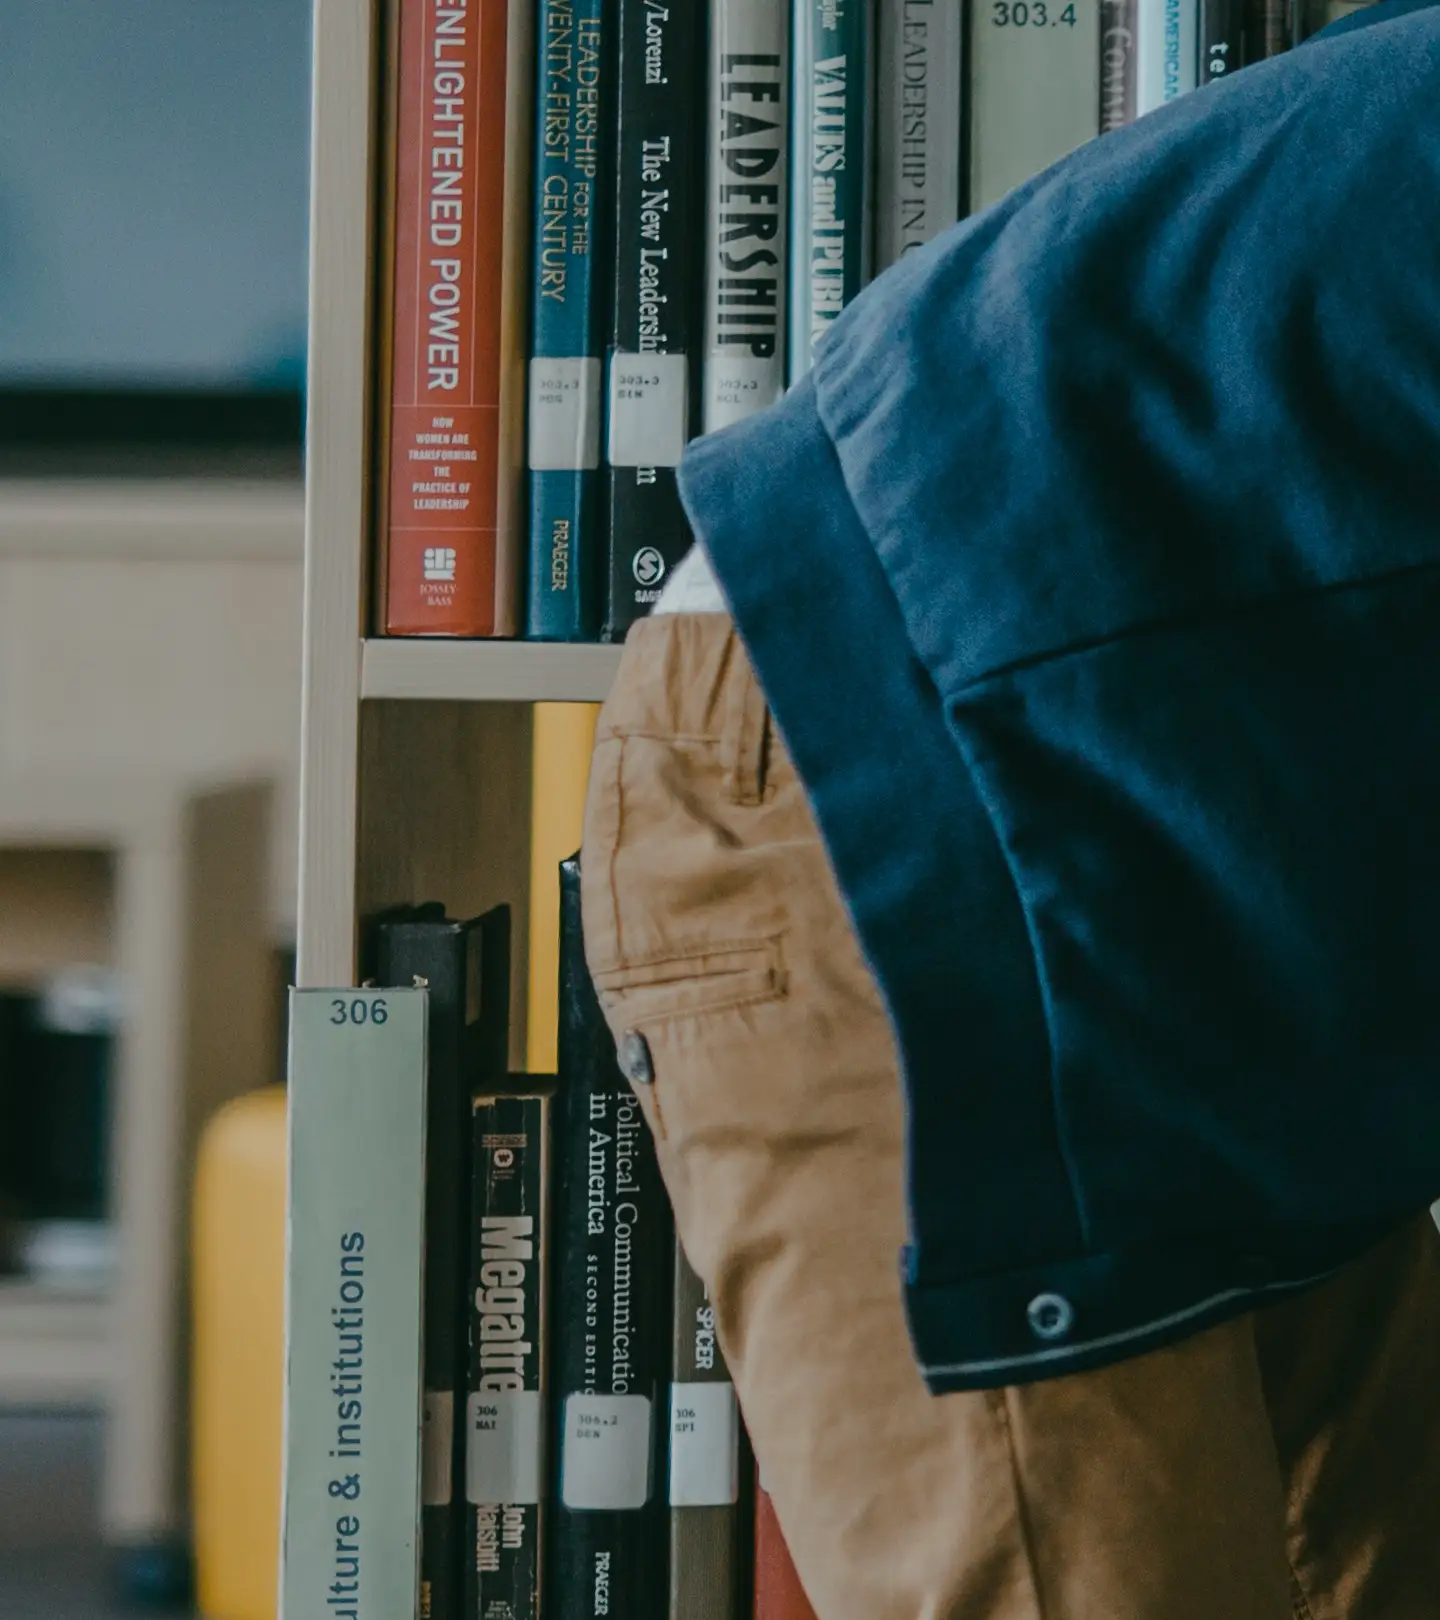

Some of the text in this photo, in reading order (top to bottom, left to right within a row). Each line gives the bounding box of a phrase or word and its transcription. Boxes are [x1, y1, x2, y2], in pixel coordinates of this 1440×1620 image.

[992, 2, 1079, 30] 303.4
[571, 18, 602, 256] LEADERSHIP FOR THE
[811, 54, 847, 231] VALUES and
[902, 0, 935, 231] LEADERSHIP IN
[427, 0, 469, 391] ENLIGHTENED POWER
[640, 136, 670, 241] The New
[717, 53, 781, 360] LEADERSHIP
[541, 174, 569, 303] CENTURY
[619, 375, 661, 388] 303.3
[415, 433, 470, 446] WOMEN ARE
[432, 416, 454, 429] HOW
[408, 450, 478, 462] TRANSFORMING
[412, 482, 472, 494] PRACTICE OF
[433, 465, 451, 478] THE
[413, 498, 470, 511] LEADERSHIP
[552, 519, 569, 592] PRAEGER
[329, 998, 389, 1026] 306
[587, 1092, 613, 1235] in America
[615, 1091, 642, 1194] Political
[585, 1253, 599, 1327] SECOND
[330, 1231, 366, 1458] institutions
[695, 1306, 715, 1370] SPICER
[476, 1405, 498, 1416] 306
[327, 1473, 361, 1501] &
[502, 1503, 527, 1549] John
[594, 1551, 612, 1617] PRAEGER
